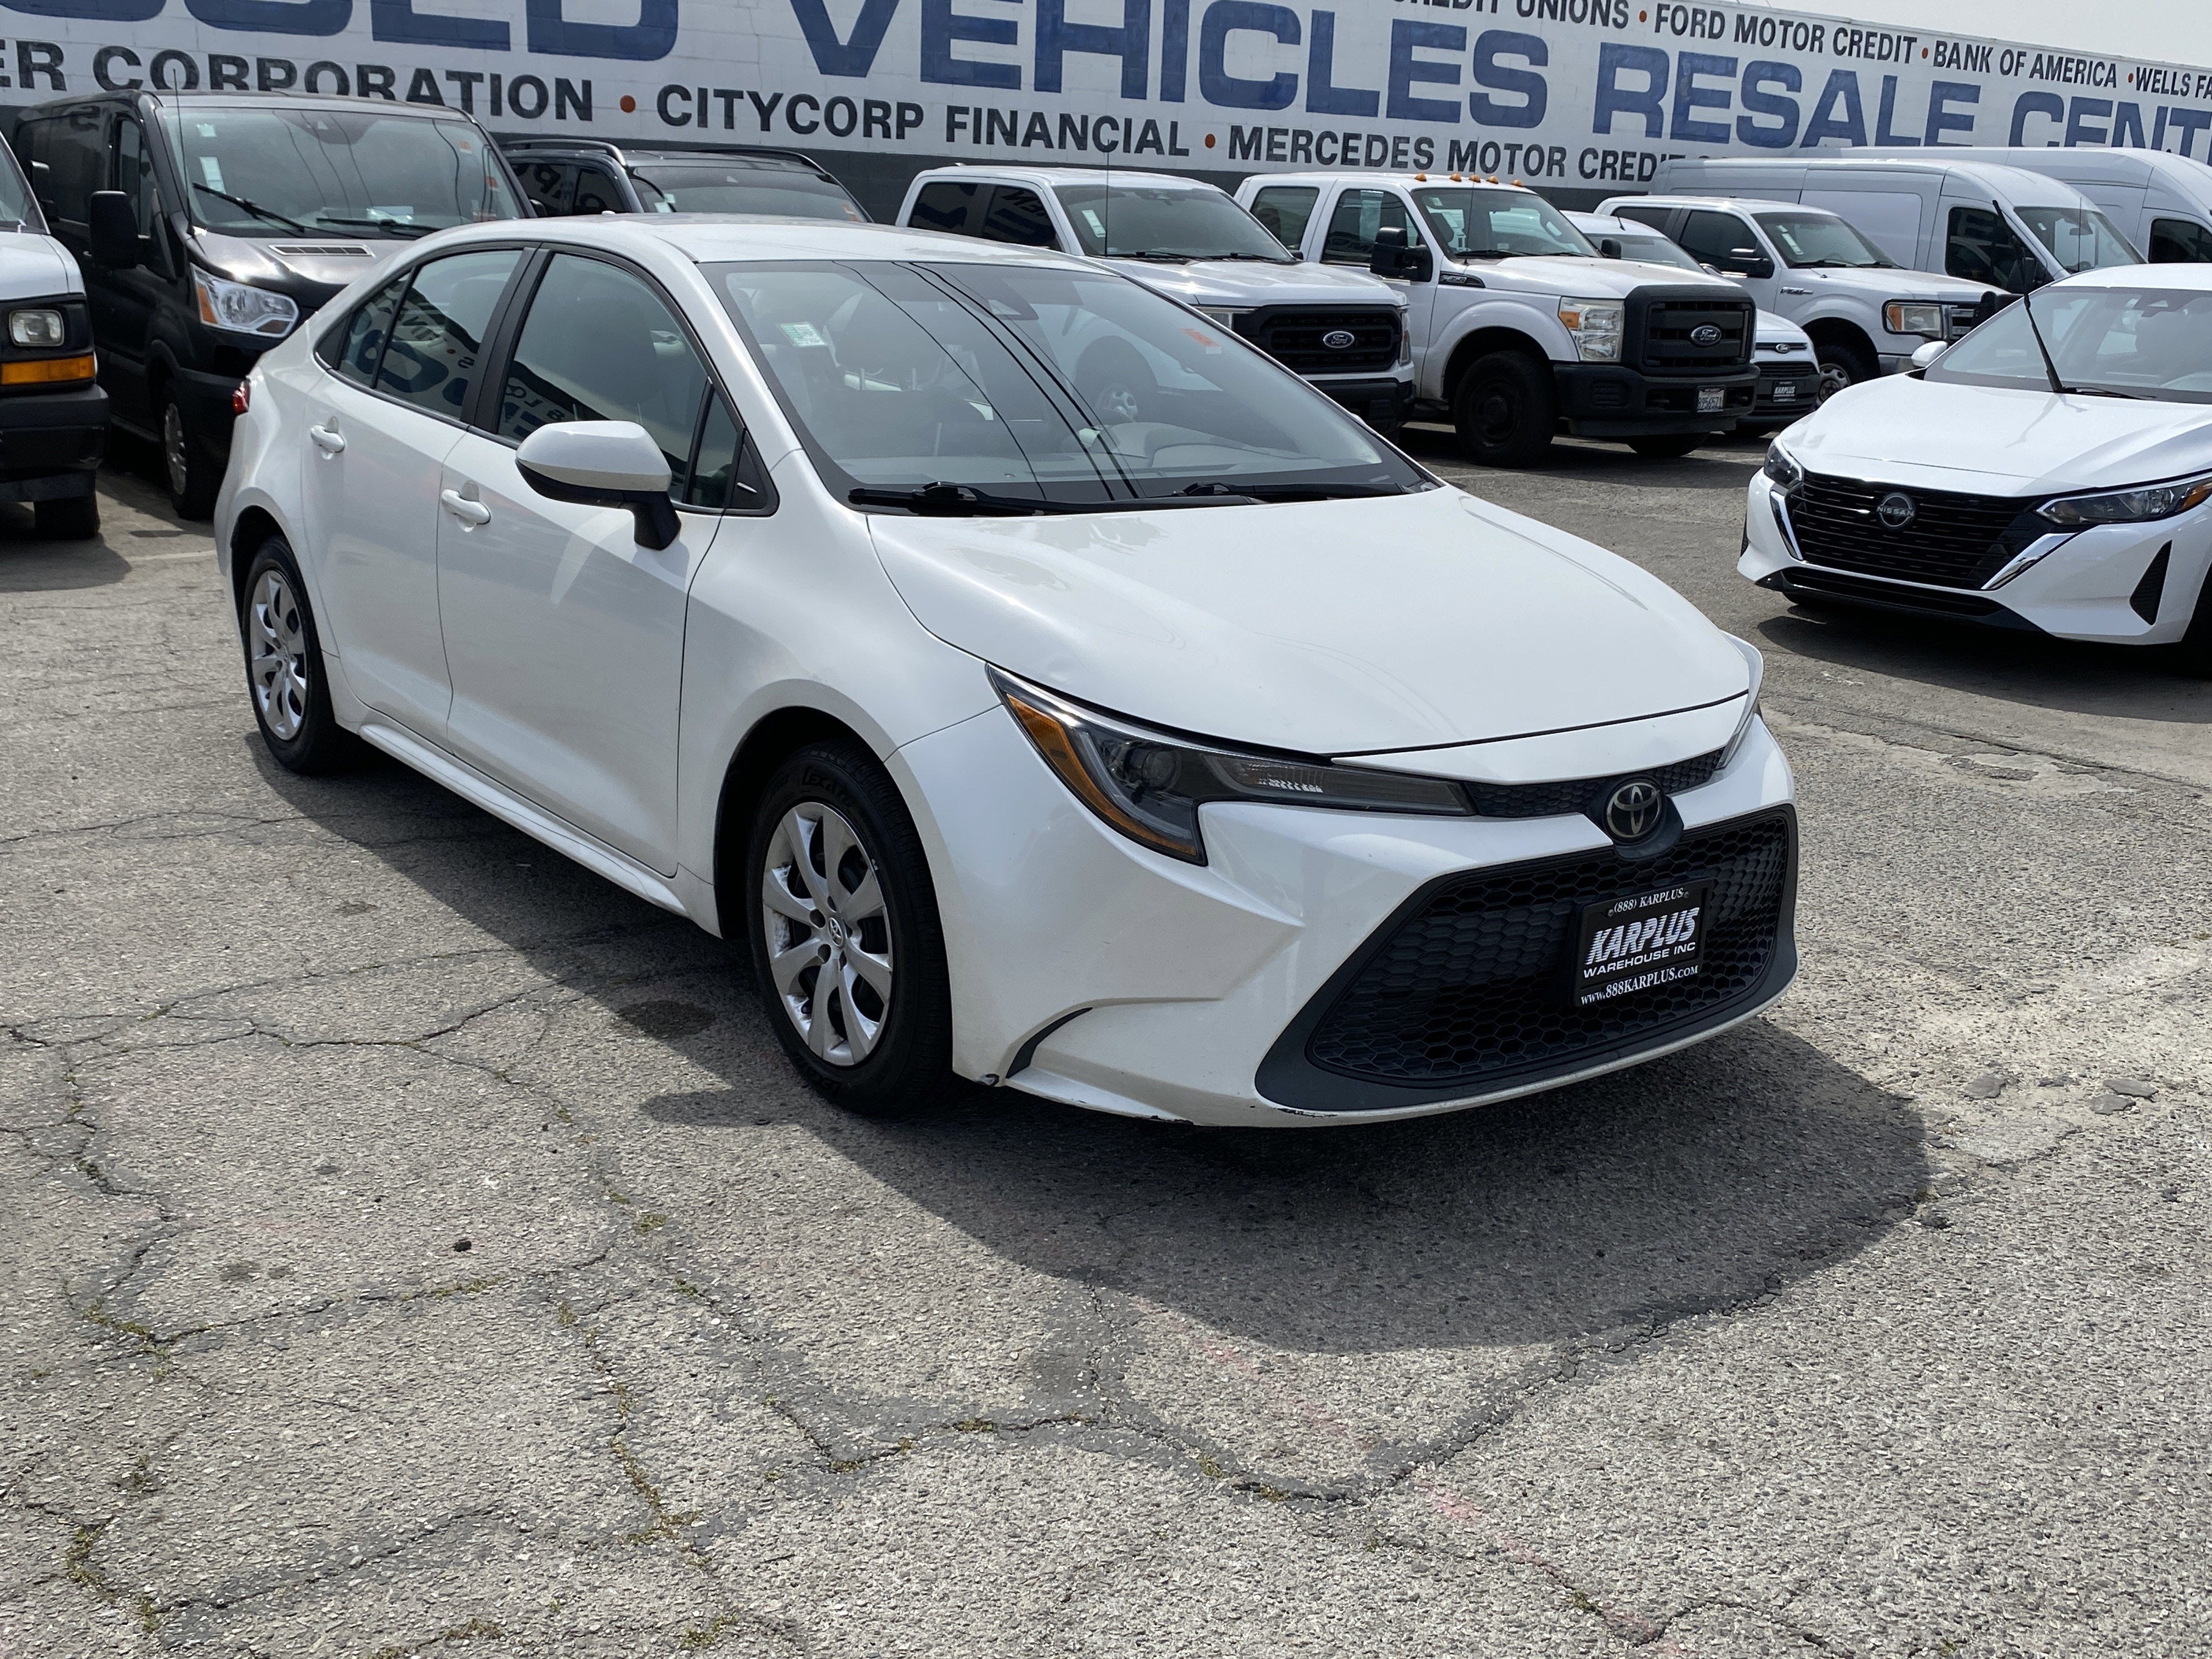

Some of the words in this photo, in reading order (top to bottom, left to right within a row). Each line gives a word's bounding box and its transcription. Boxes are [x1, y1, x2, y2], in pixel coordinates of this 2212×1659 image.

[1516, 0, 1628, 29] UNIONS
[1655, 4, 1725, 40] FORD
[1734, 14, 1825, 53] MOTOR
[1833, 27, 1917, 64] CREDIT
[0, 39, 66, 91] R
[93, 46, 592, 121] CORPORATION
[789, 0, 1549, 129] VEHICLES
[1593, 42, 1981, 149] RESALE
[2008, 91, 2212, 166] CENT
[1933, 40, 1993, 74] BANK
[2000, 48, 2025, 76] OF
[2029, 52, 2117, 88] AMERICA
[2136, 66, 2191, 97] WELLS
[657, 84, 924, 140] CITYCORP
[945, 105, 1189, 156] FINANCIAL
[1228, 125, 1434, 170] MERCEDES
[1447, 139, 1565, 178] MOTOR
[1578, 147, 1685, 182] CRED
[1877, 506, 1914, 516] NISSAN
[1614, 899, 1637, 913] (888)
[1639, 887, 1684, 908] KARPLUS
[1583, 948, 1670, 978] WAREHOUSE
[1674, 942, 1696, 955] INC
[1584, 907, 1700, 965] KARPLUS
